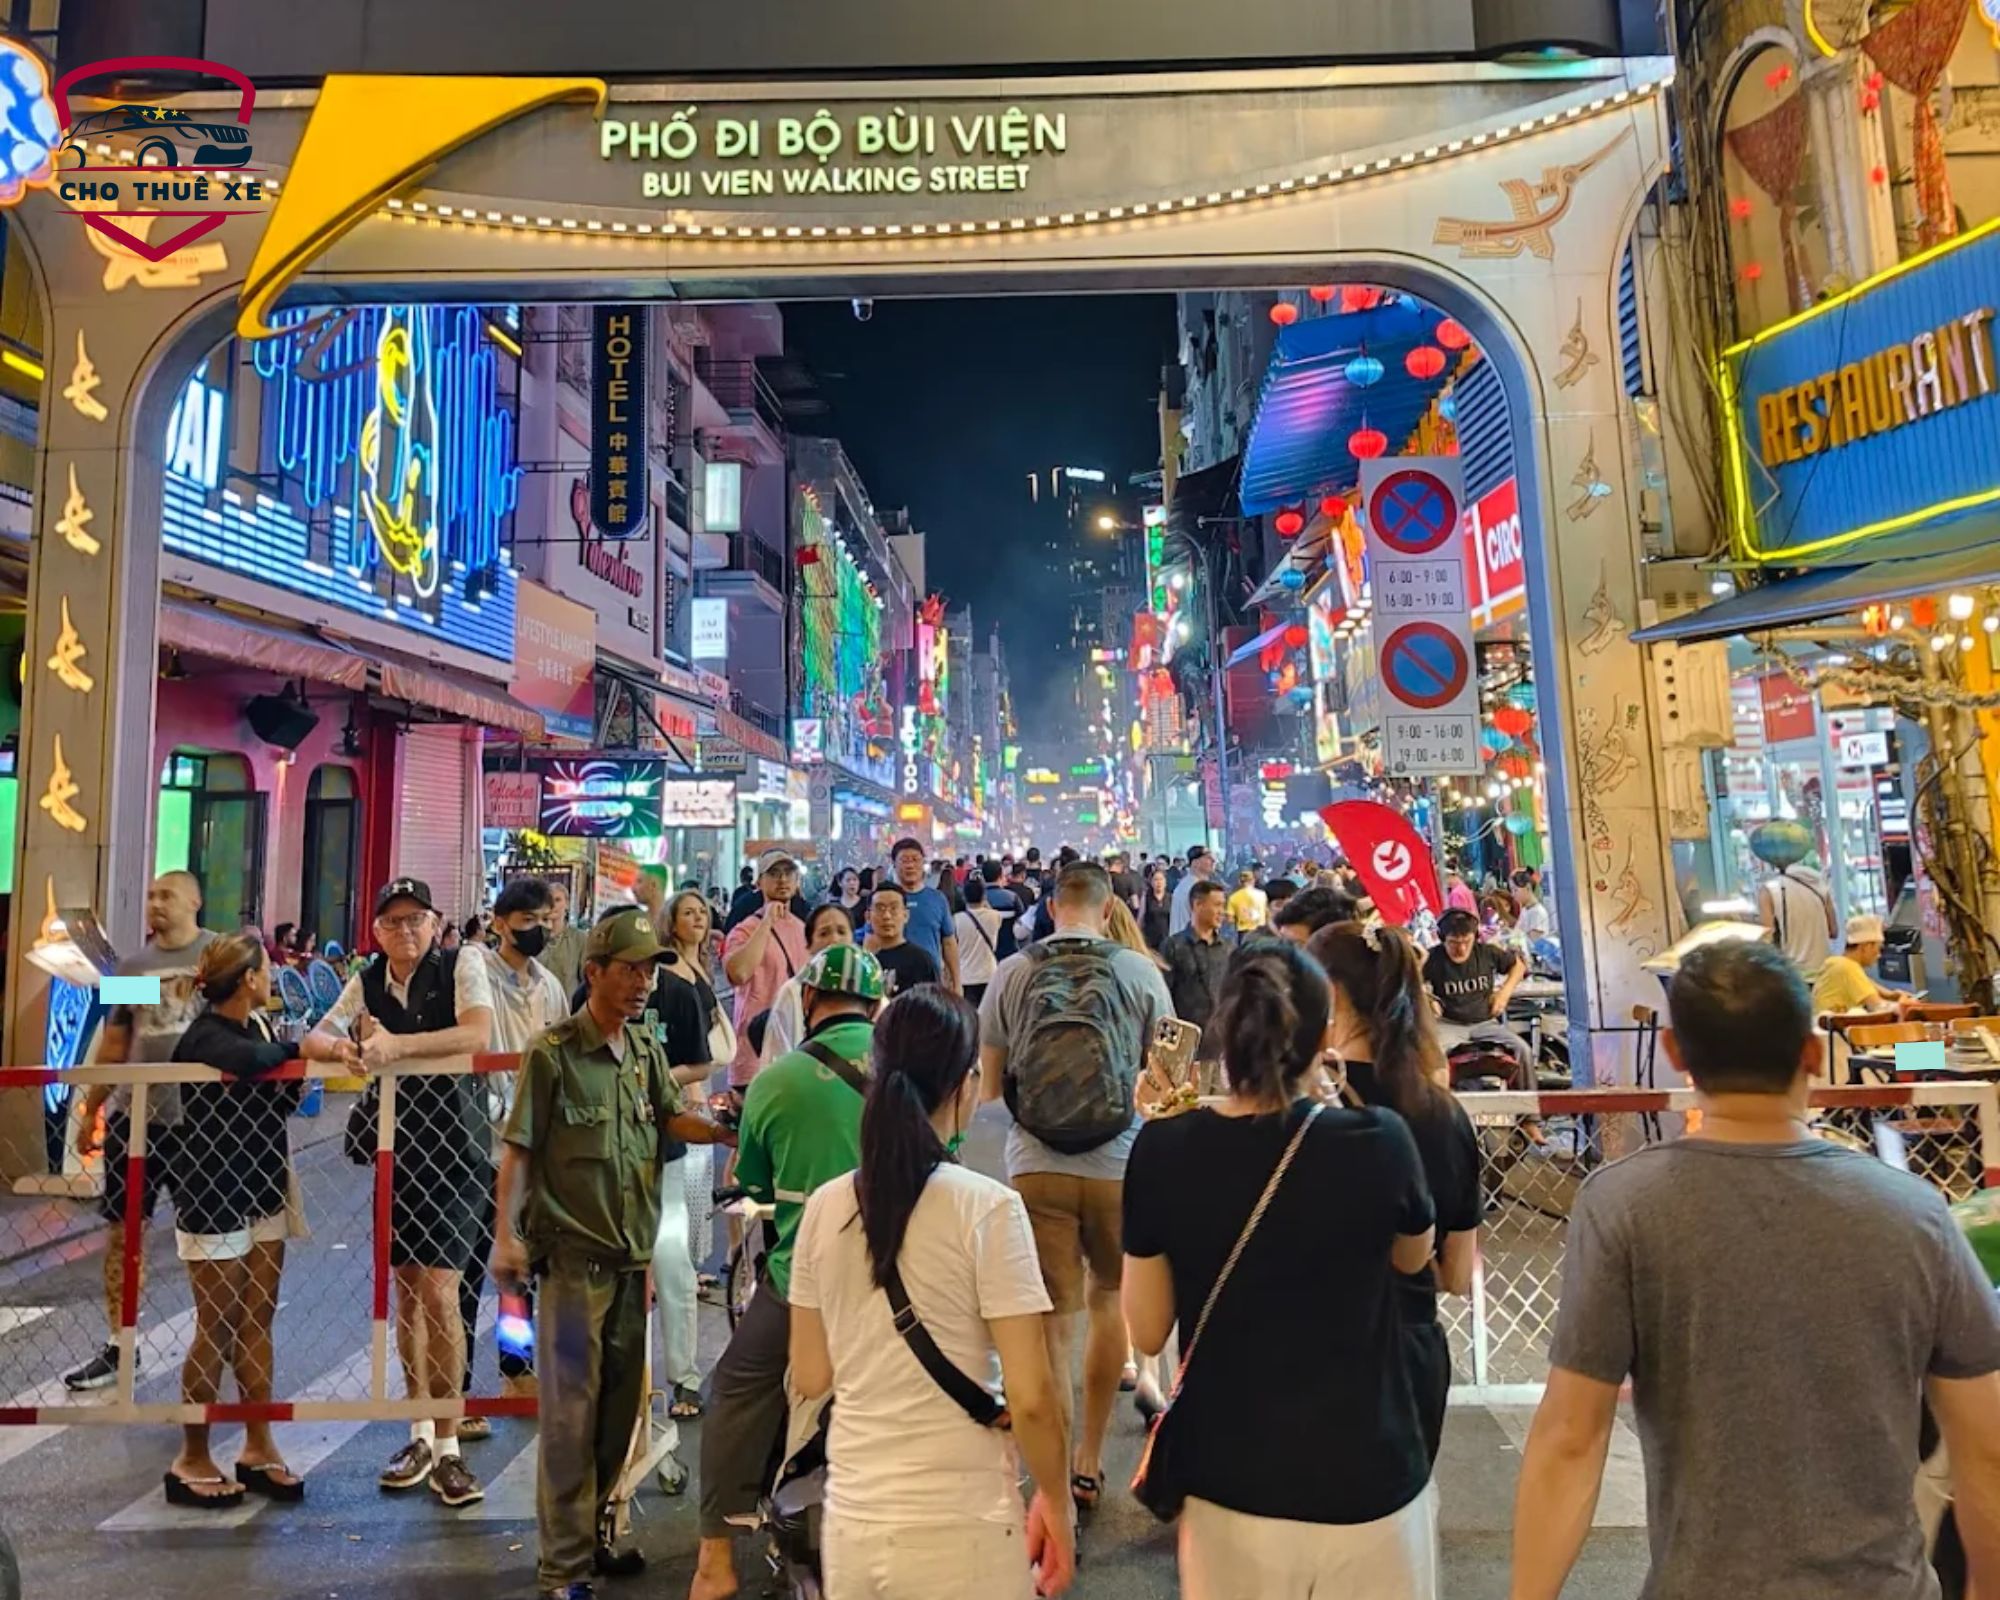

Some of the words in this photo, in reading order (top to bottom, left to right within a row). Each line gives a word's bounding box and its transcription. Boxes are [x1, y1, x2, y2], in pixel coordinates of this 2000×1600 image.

[601, 105, 698, 159] PHỐ
[715, 119, 759, 158] ĐI
[778, 109, 841, 163] BỘ
[858, 106, 935, 154] BÙI
[951, 106, 1066, 159] VIỆN
[642, 171, 691, 197] BUI
[701, 169, 773, 196] VIEN
[782, 165, 922, 193] WALKING
[929, 164, 1029, 192] STREET
[606, 315, 631, 423] HOTEL
[1757, 307, 1995, 468] RESTAURANT
[1434, 724, 1463, 738] 16:00
[1444, 976, 1490, 995] DIOR
